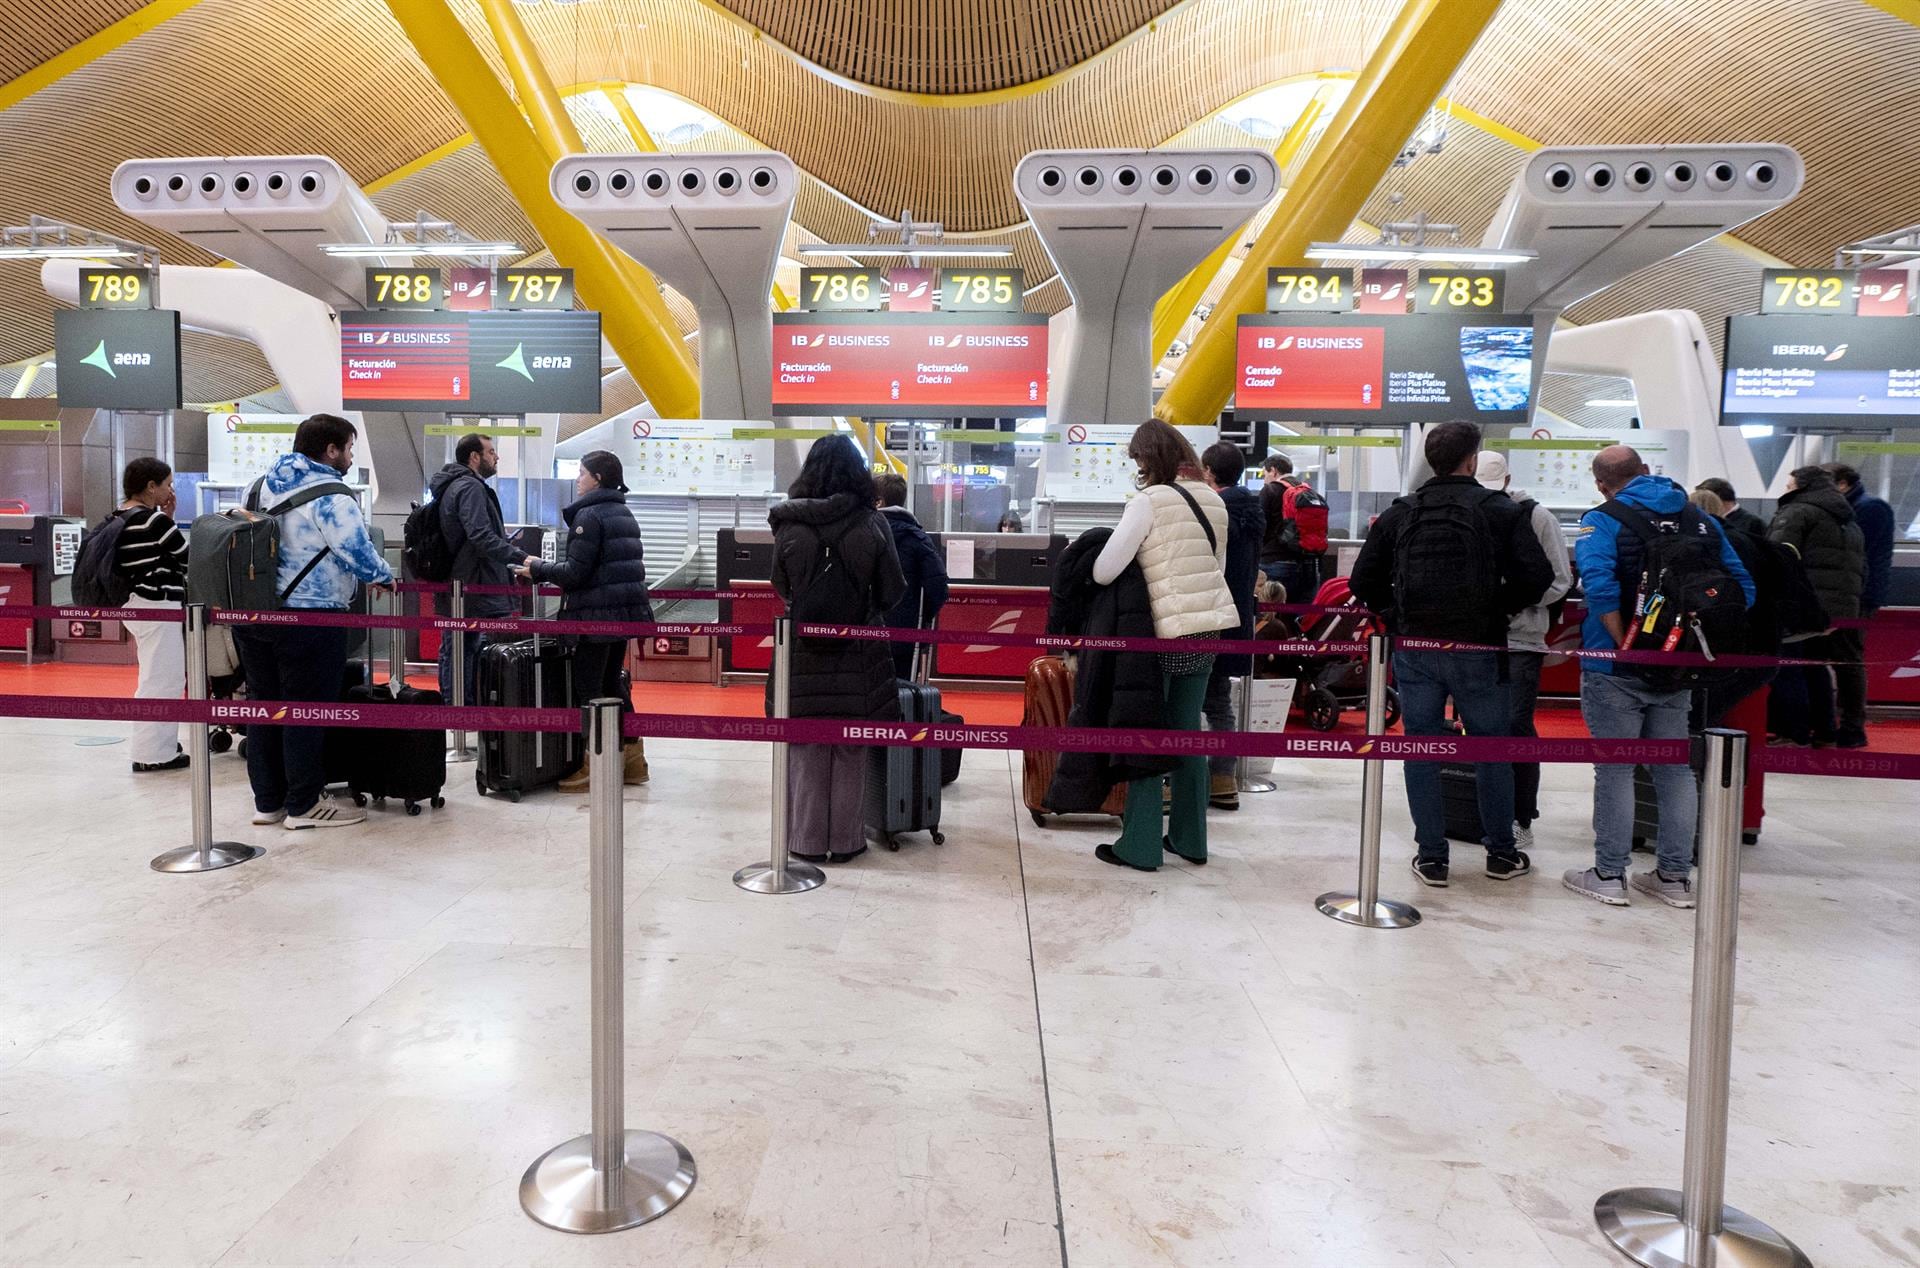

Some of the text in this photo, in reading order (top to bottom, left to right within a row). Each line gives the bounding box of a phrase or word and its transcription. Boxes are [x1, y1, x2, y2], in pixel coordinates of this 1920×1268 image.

[87, 275, 140, 302] 789
[374, 275, 432, 302] 788
[454, 282, 468, 292] IB
[507, 275, 563, 302] 787
[809, 275, 870, 303] 786
[893, 283, 909, 292] IB
[951, 276, 1013, 304] 785
[1277, 275, 1342, 303] 784
[1365, 284, 1382, 294] IB
[1428, 277, 1494, 306] 783
[1775, 277, 1843, 307] 782
[1863, 285, 1882, 295] IB
[358, 333, 451, 344] IB BUSINESS
[791, 335, 890, 346] IB BUSINESS
[928, 335, 1029, 347] IB BUSINESS
[1257, 337, 1363, 349] IB BUSINESS
[1772, 345, 1827, 355] IBERIA
[113, 352, 151, 366] aena
[348, 359, 396, 369] Facturación
[532, 356, 572, 368] aena
[780, 362, 831, 372] Facturación
[917, 363, 969, 373] Facturación
[1245, 366, 1282, 376] Cerrado
[349, 370, 372, 379] Check
[780, 374, 806, 383] Check
[917, 375, 943, 384] Check
[1407, 371, 1435, 380] Singular
[1245, 377, 1275, 387] Closed
[60, 609, 137, 618] IBERIA BUSINESS
[216, 612, 299, 622] IBERIA BUSINESS
[434, 620, 518, 630] IBERIA BUSINESS
[657, 625, 743, 634] IBERIA BUSINESS
[803, 627, 890, 638] IBERIA BUSINESS
[1035, 637, 1127, 648] IBERIA BUSINESS
[1402, 639, 1441, 649] IBERIA
[1278, 644, 1369, 652] IBERIA BUSINES
[211, 705, 360, 721] IBERIA BUSINESS
[842, 726, 1008, 743] IBERIA BUSINESS
[1286, 739, 1457, 754] IBERIA BUSINESS
